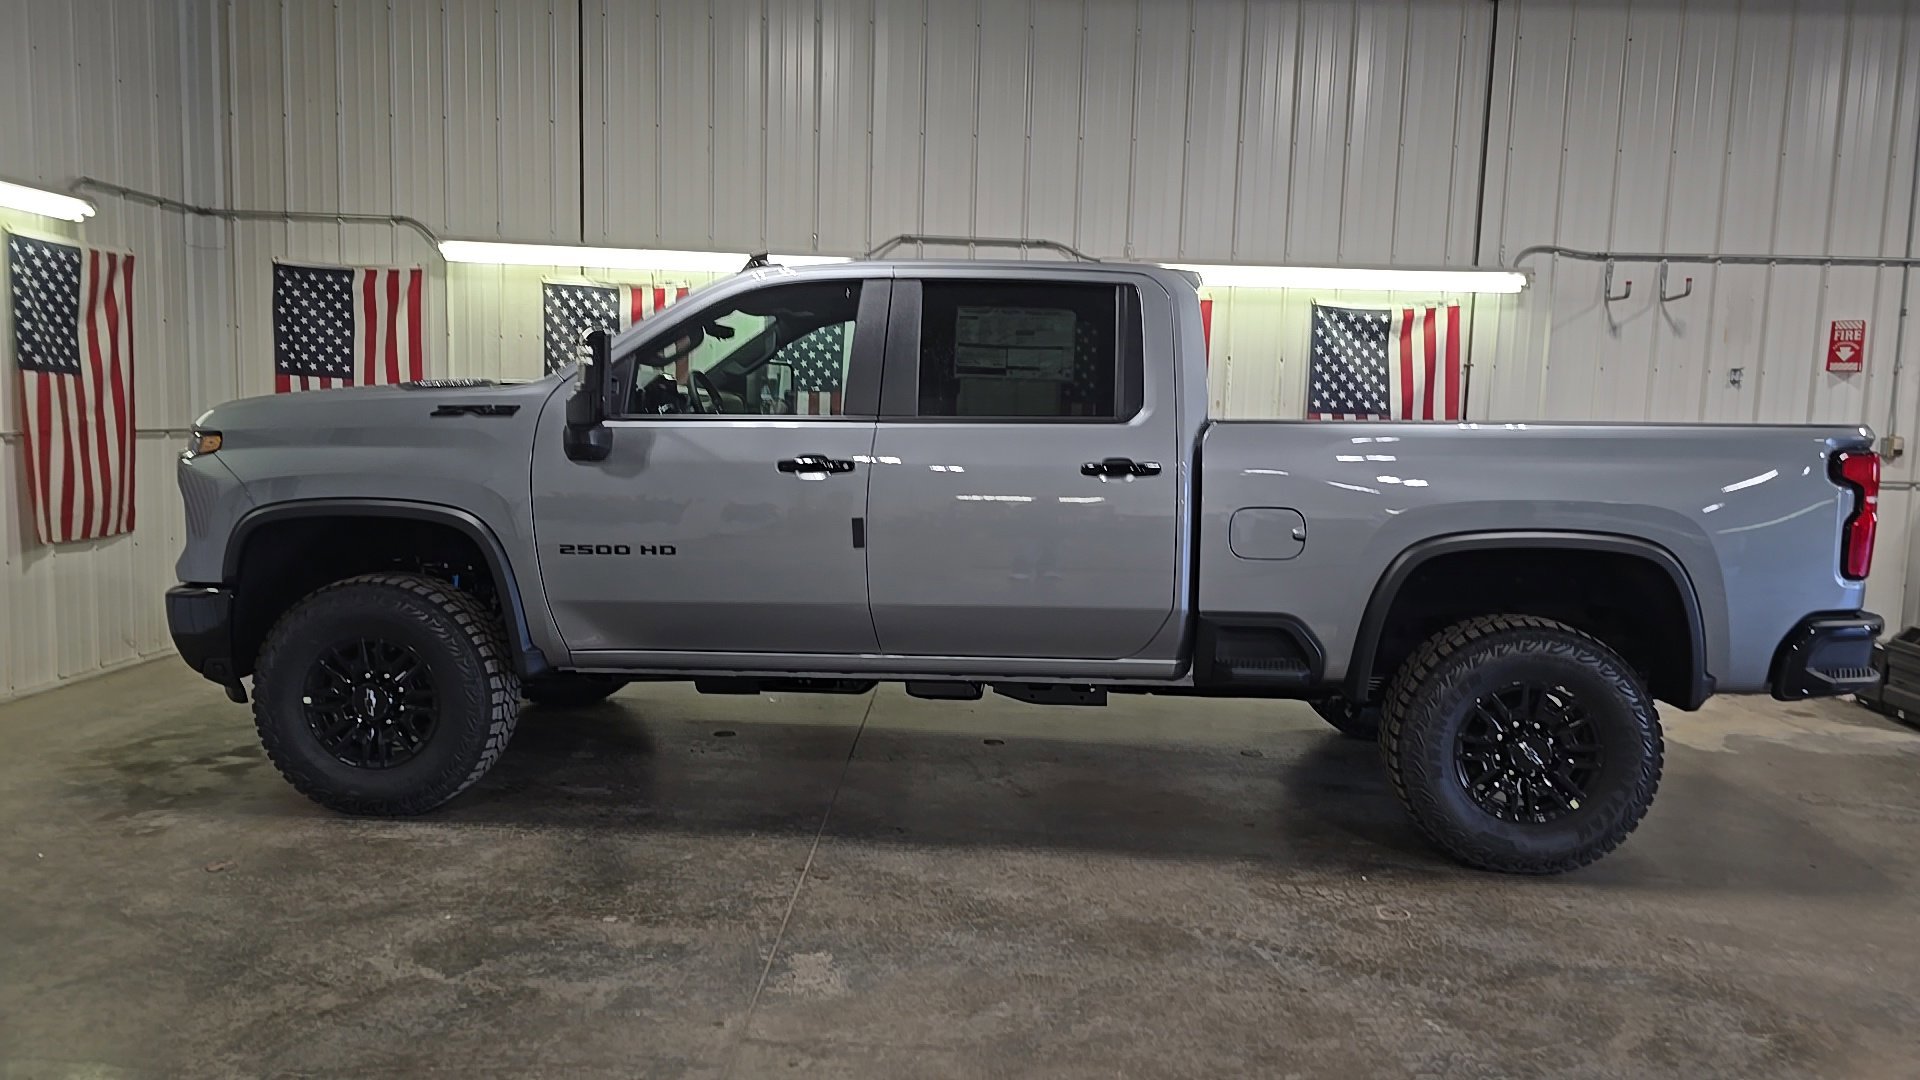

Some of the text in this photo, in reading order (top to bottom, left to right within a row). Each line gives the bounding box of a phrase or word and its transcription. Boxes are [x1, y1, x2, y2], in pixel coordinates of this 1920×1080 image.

[1834, 329, 1862, 341] FIRE
[559, 544, 676, 555] 2500 HD
